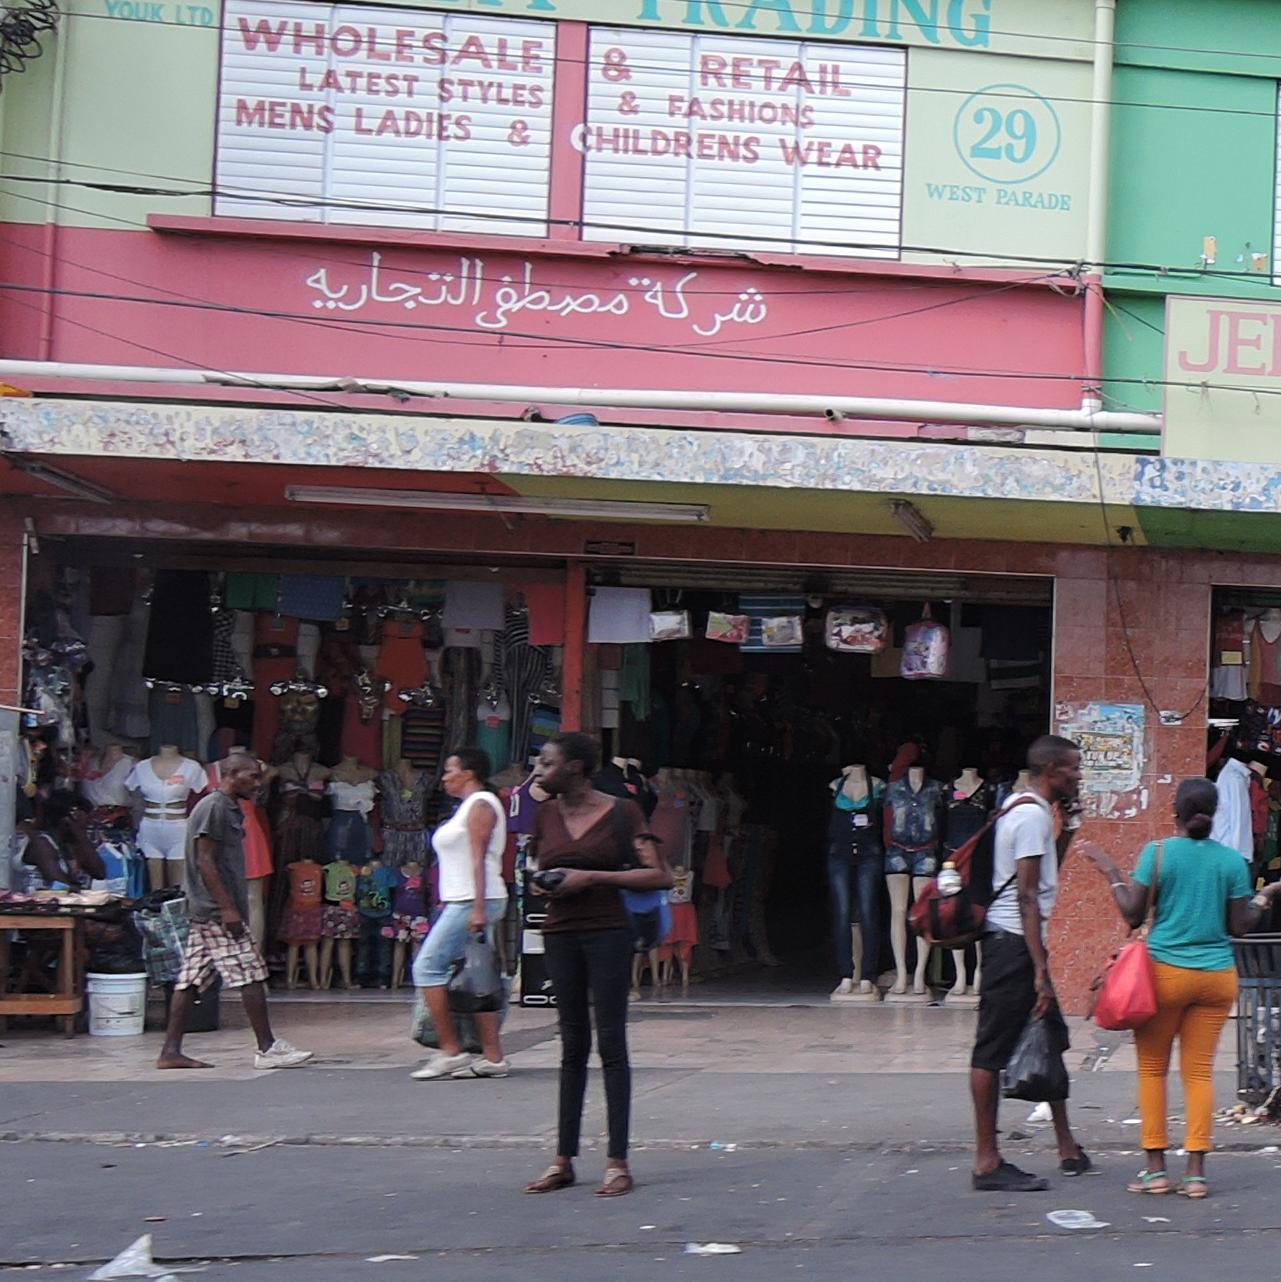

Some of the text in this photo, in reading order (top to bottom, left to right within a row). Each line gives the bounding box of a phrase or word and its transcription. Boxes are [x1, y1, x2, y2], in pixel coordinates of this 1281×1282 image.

[176, 7, 214, 25] LTD
[236, 16, 852, 98] WHOLESALE & RETAIL
[299, 66, 815, 129] LATEST STYLES & FASHIONS
[235, 98, 882, 172] MENS LADIES & CHILDRENS WEAR
[970, 107, 1037, 164] 29
[925, 183, 1072, 212] WEST PARADE
